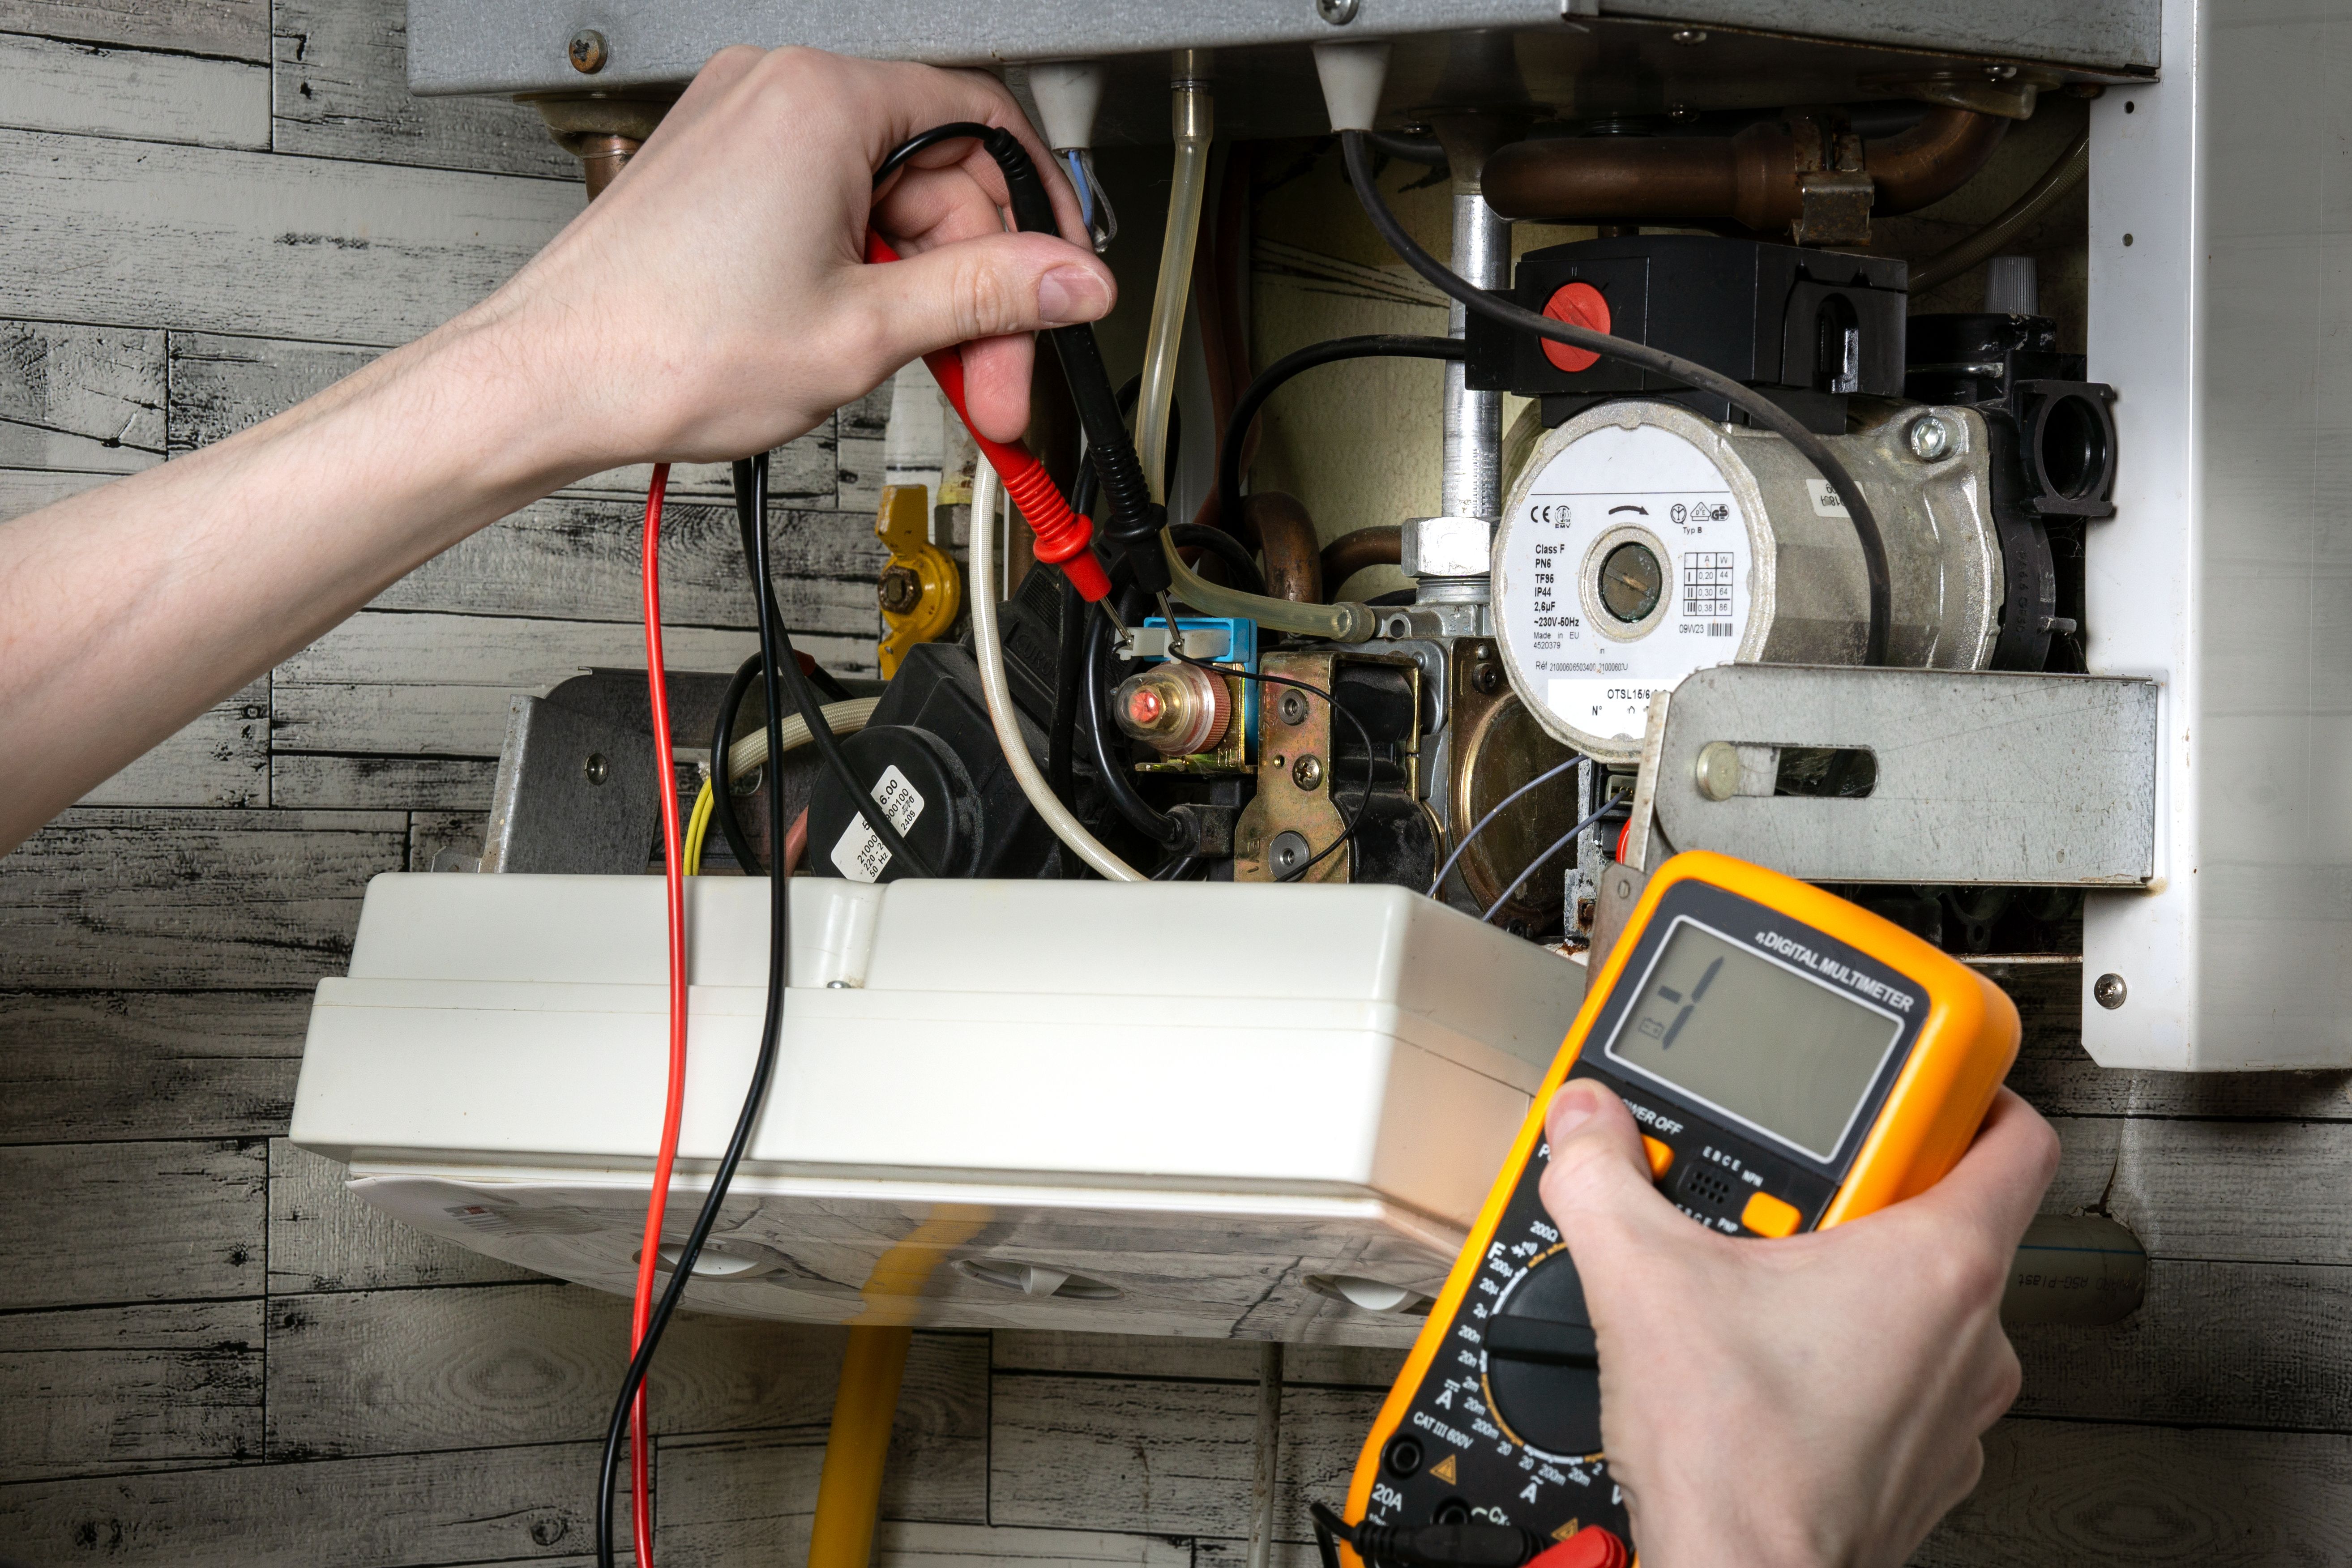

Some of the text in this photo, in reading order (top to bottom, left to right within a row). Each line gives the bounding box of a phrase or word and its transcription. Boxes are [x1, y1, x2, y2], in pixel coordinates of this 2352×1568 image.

[1712, 506, 1728, 520] GS
[1683, 527, 1695, 535] Typ
[1535, 544, 1565, 554] Class F
[1535, 558, 1551, 568] PN6
[1698, 572, 1713, 581] 0,20
[1535, 587, 1551, 597] IP44
[1698, 589, 1713, 597] 0,30
[1534, 601, 1555, 613] 2,6µF
[1698, 604, 1712, 613] 0,38
[869, 867, 879, 877] 50
[878, 852, 889, 865] Hz
[901, 811, 915, 831] 2409
[1764, 931, 1914, 1013] DIGITAL MULTIMETER
[1655, 1116, 1684, 1135] OFF
[1487, 1241, 1506, 1260] F
[1463, 1396, 1486, 1416] 20m
[1413, 1411, 1436, 1430] CAT
[1446, 1428, 1474, 1450] 600V
[1471, 1417, 1500, 1440] 200m
[1497, 1440, 1512, 1456] 20
[1518, 1455, 1535, 1470] 20
[1538, 1463, 1566, 1486] 200m
[1371, 1483, 1402, 1512] 20A
